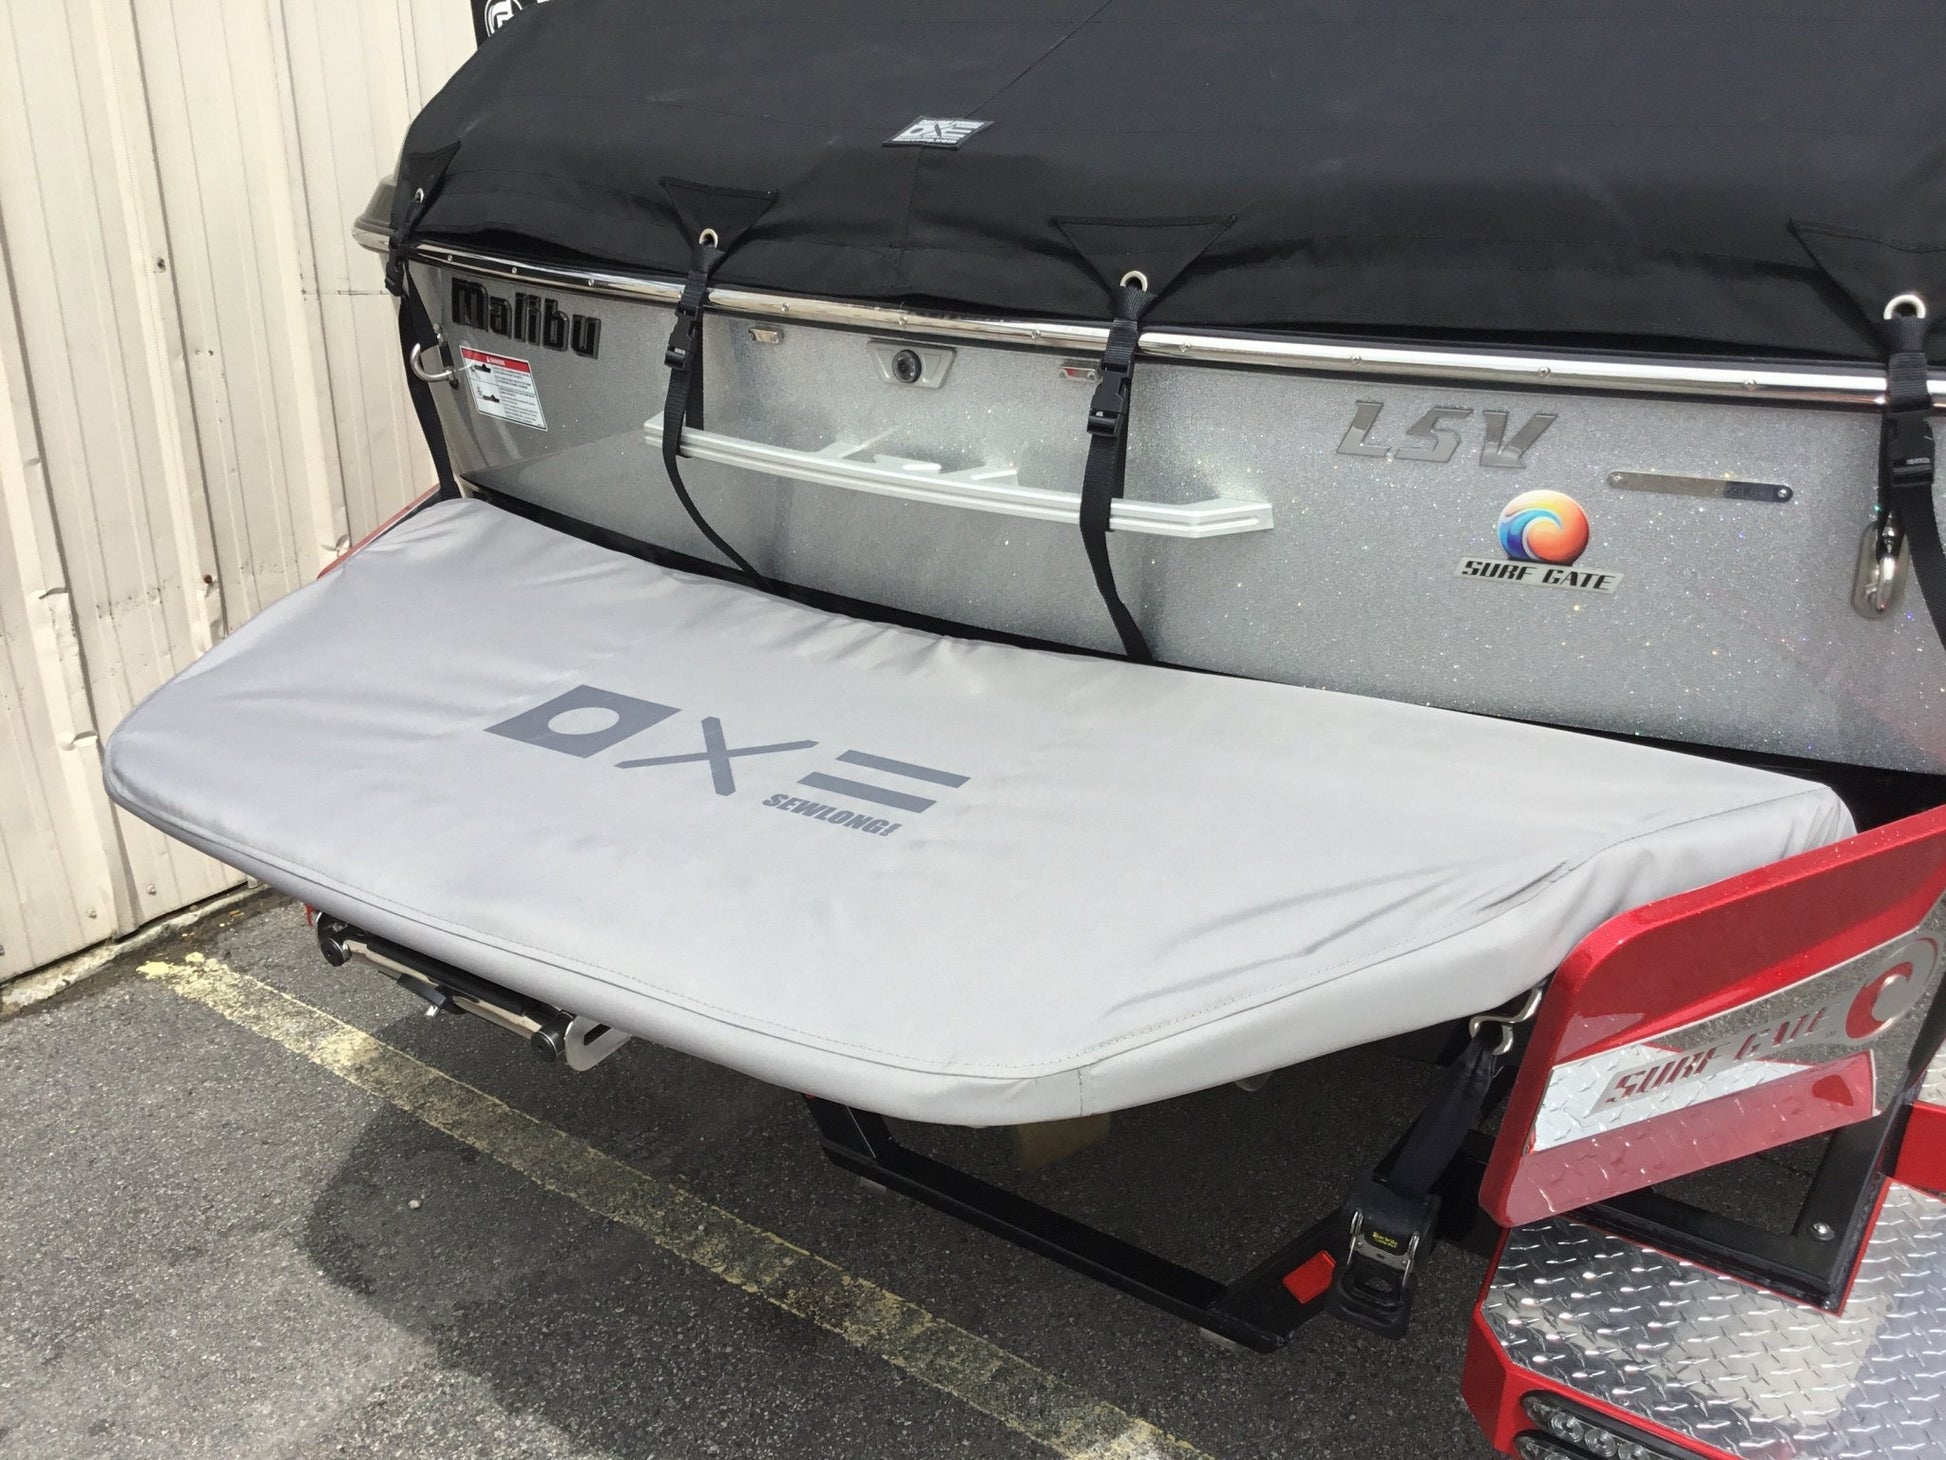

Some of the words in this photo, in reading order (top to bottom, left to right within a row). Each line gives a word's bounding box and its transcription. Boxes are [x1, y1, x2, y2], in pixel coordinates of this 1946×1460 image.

[451, 277, 601, 359] Malibu
[1337, 400, 1558, 469] LSV
[1461, 560, 1537, 581] SURF
[1542, 568, 1617, 590] GATE
[762, 793, 903, 837] SEWLONG!
[1605, 1042, 1732, 1103] SURF
[1734, 1002, 1840, 1061] GATE
